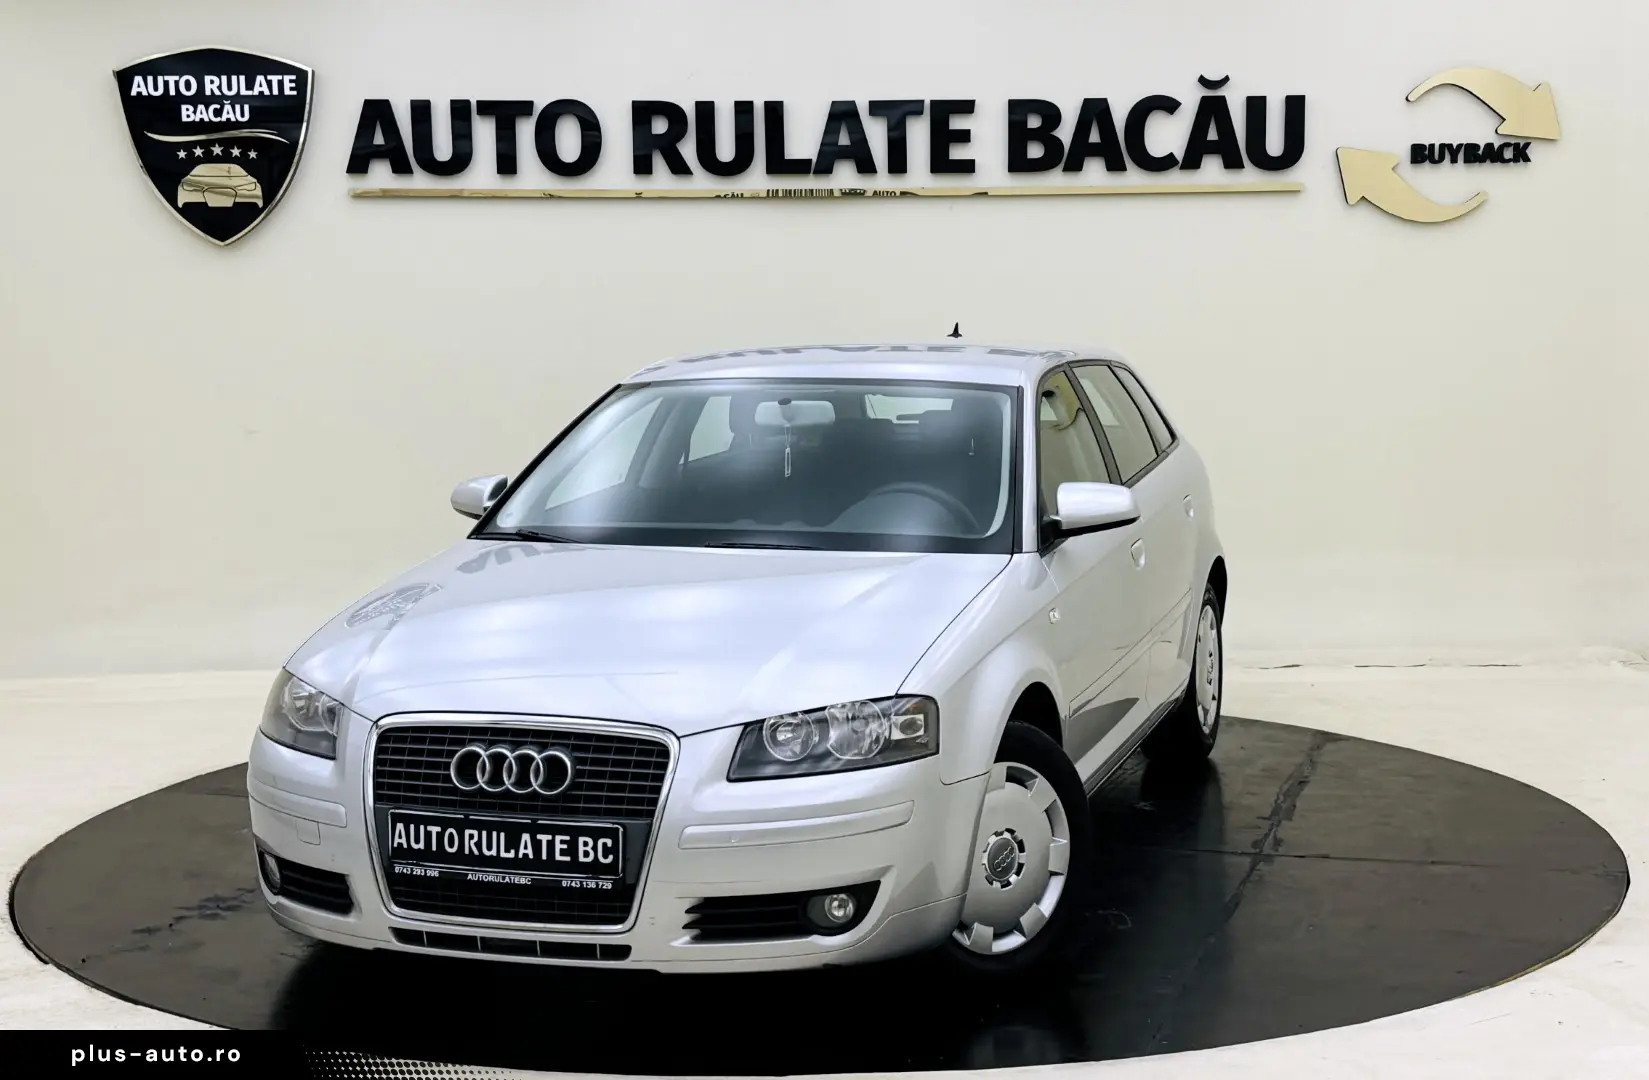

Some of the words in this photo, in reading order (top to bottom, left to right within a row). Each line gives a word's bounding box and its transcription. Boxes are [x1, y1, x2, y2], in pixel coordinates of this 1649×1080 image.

[130, 75, 198, 97] AUTO
[204, 75, 298, 96] RULATE
[180, 100, 250, 122] BACĂU
[346, 98, 603, 178] AUTO
[632, 99, 976, 178] RULATE
[1007, 74, 1306, 174] BACĂU
[1410, 142, 1532, 164] BUYBACK
[393, 822, 459, 853] AUTO
[464, 829, 571, 862] RULATE
[578, 836, 614, 864] BC
[394, 866, 411, 874] 0743
[467, 873, 532, 884] AUTORULATEBC
[561, 880, 581, 888] 0743
[598, 882, 613, 890] 729
